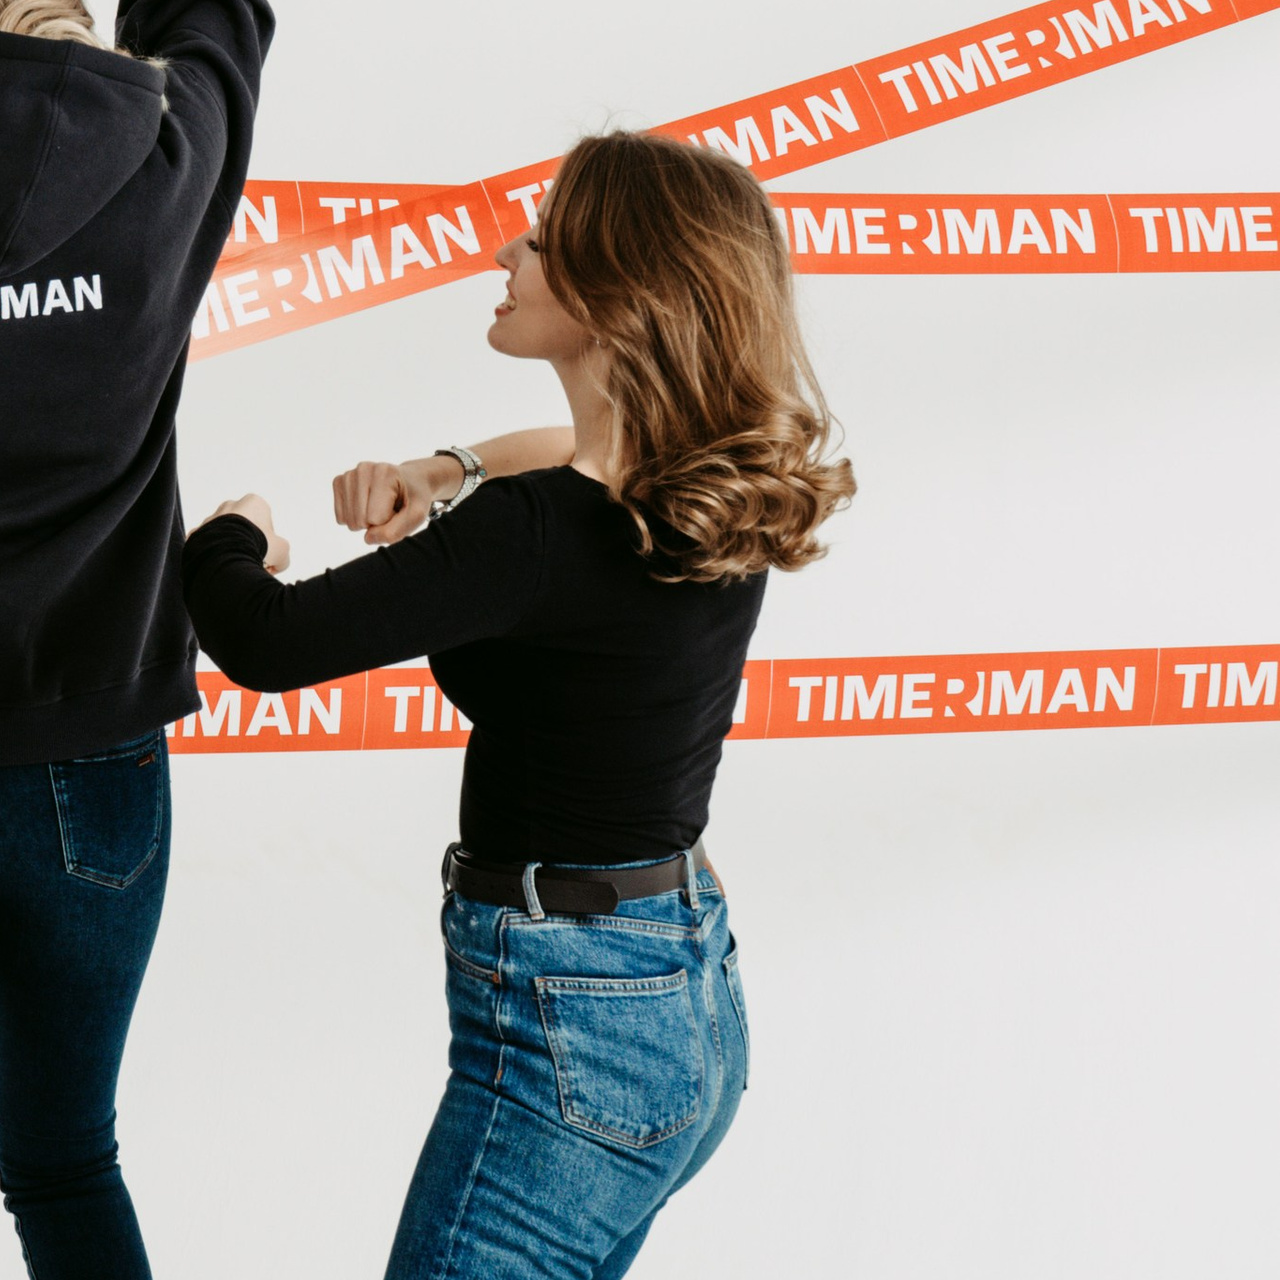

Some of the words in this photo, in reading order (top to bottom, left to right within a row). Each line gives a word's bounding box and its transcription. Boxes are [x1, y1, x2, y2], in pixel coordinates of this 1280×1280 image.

[687, 87, 861, 168] MAN
[1127, 206, 1279, 253] TIME
[788, 666, 1136, 722] TIMERMAN
